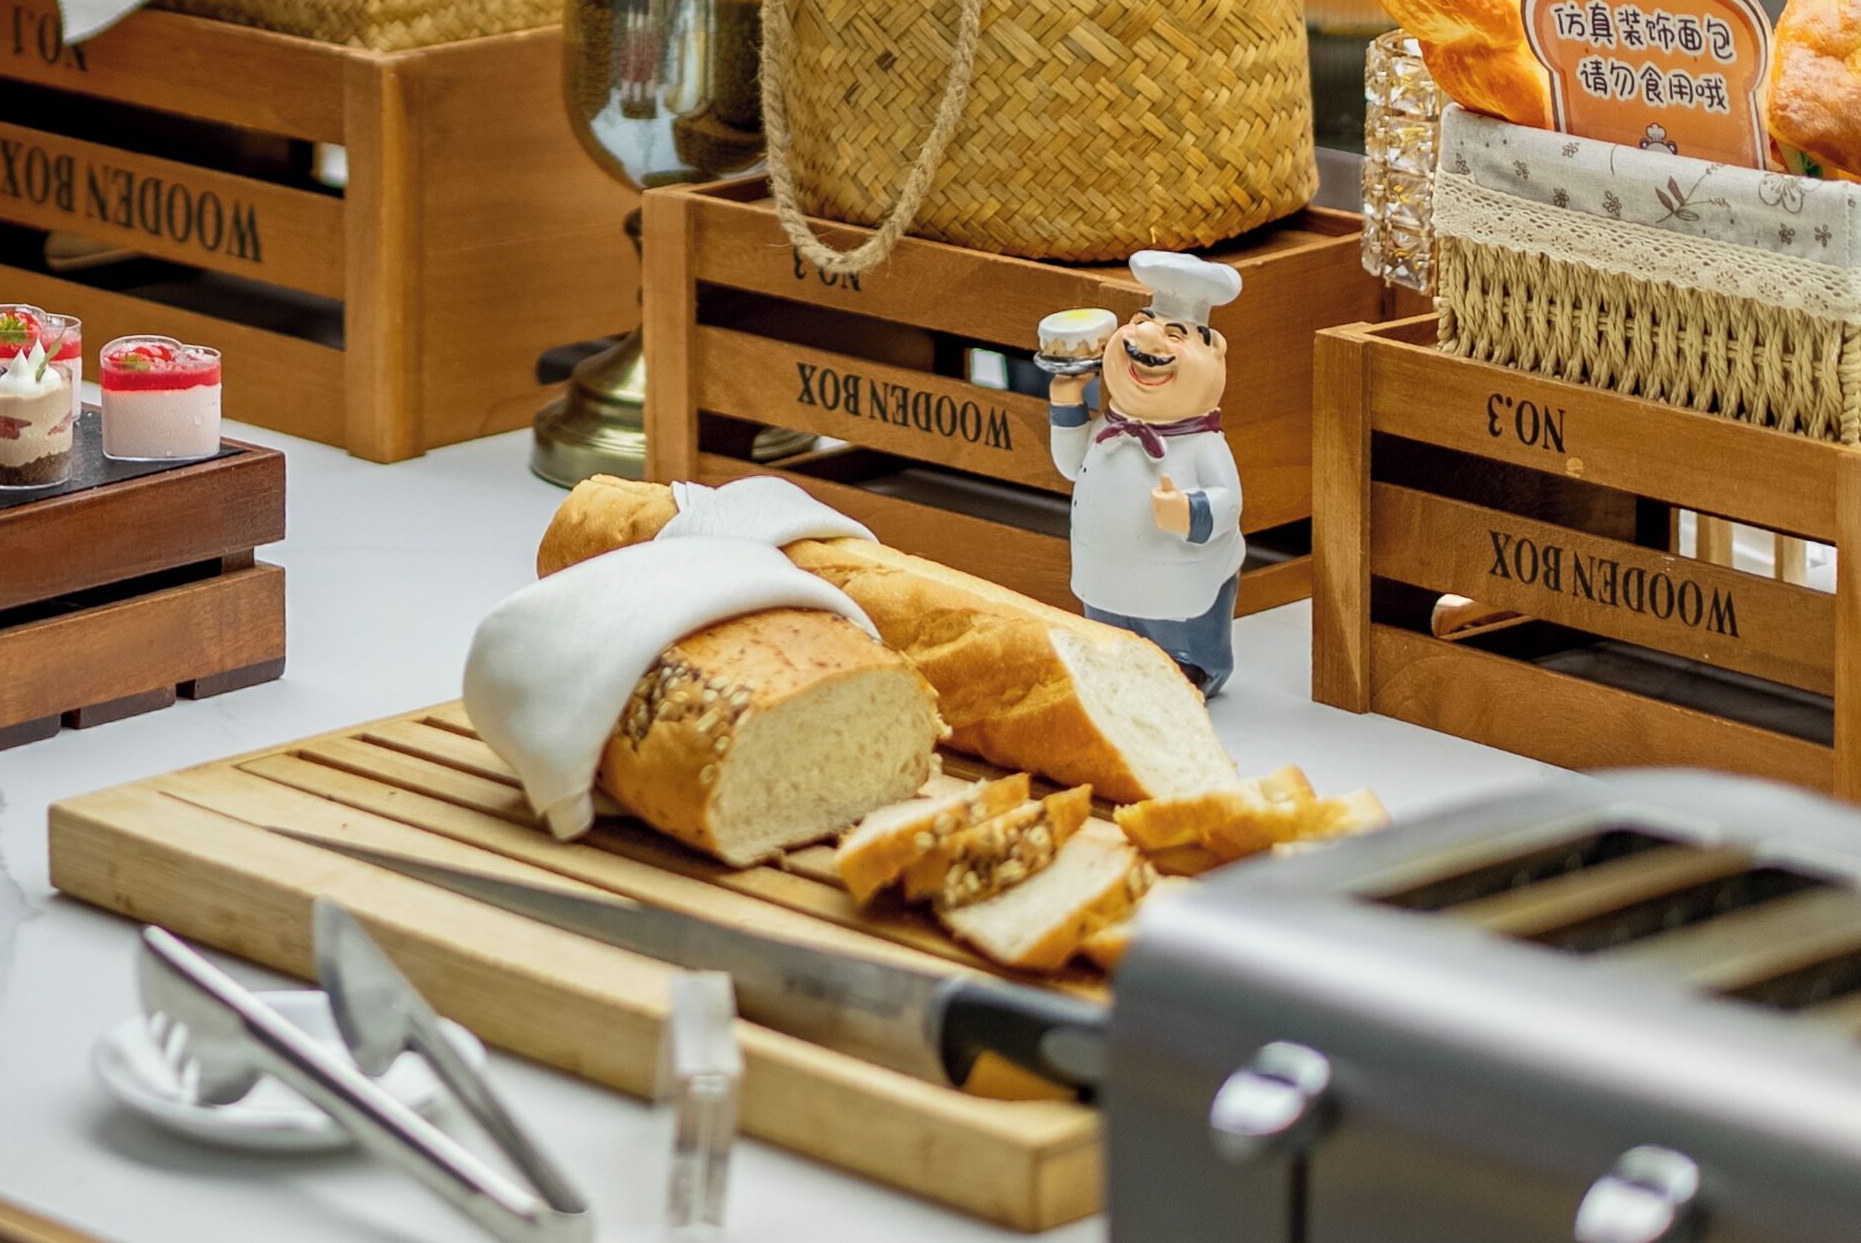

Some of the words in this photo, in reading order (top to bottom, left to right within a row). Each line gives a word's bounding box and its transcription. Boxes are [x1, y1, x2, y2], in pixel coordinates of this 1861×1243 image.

[1553, 2, 1734, 60] 仿真装饰面包
[1580, 59, 1727, 110] 请勿食用哦
[85, 161, 262, 263] WOODEN
[796, 361, 862, 417] BOX
[868, 378, 1014, 451] WOODEN
[1486, 392, 1567, 454] NO.3
[1488, 529, 1564, 593] BOX
[1572, 551, 1740, 638] WOODEN
